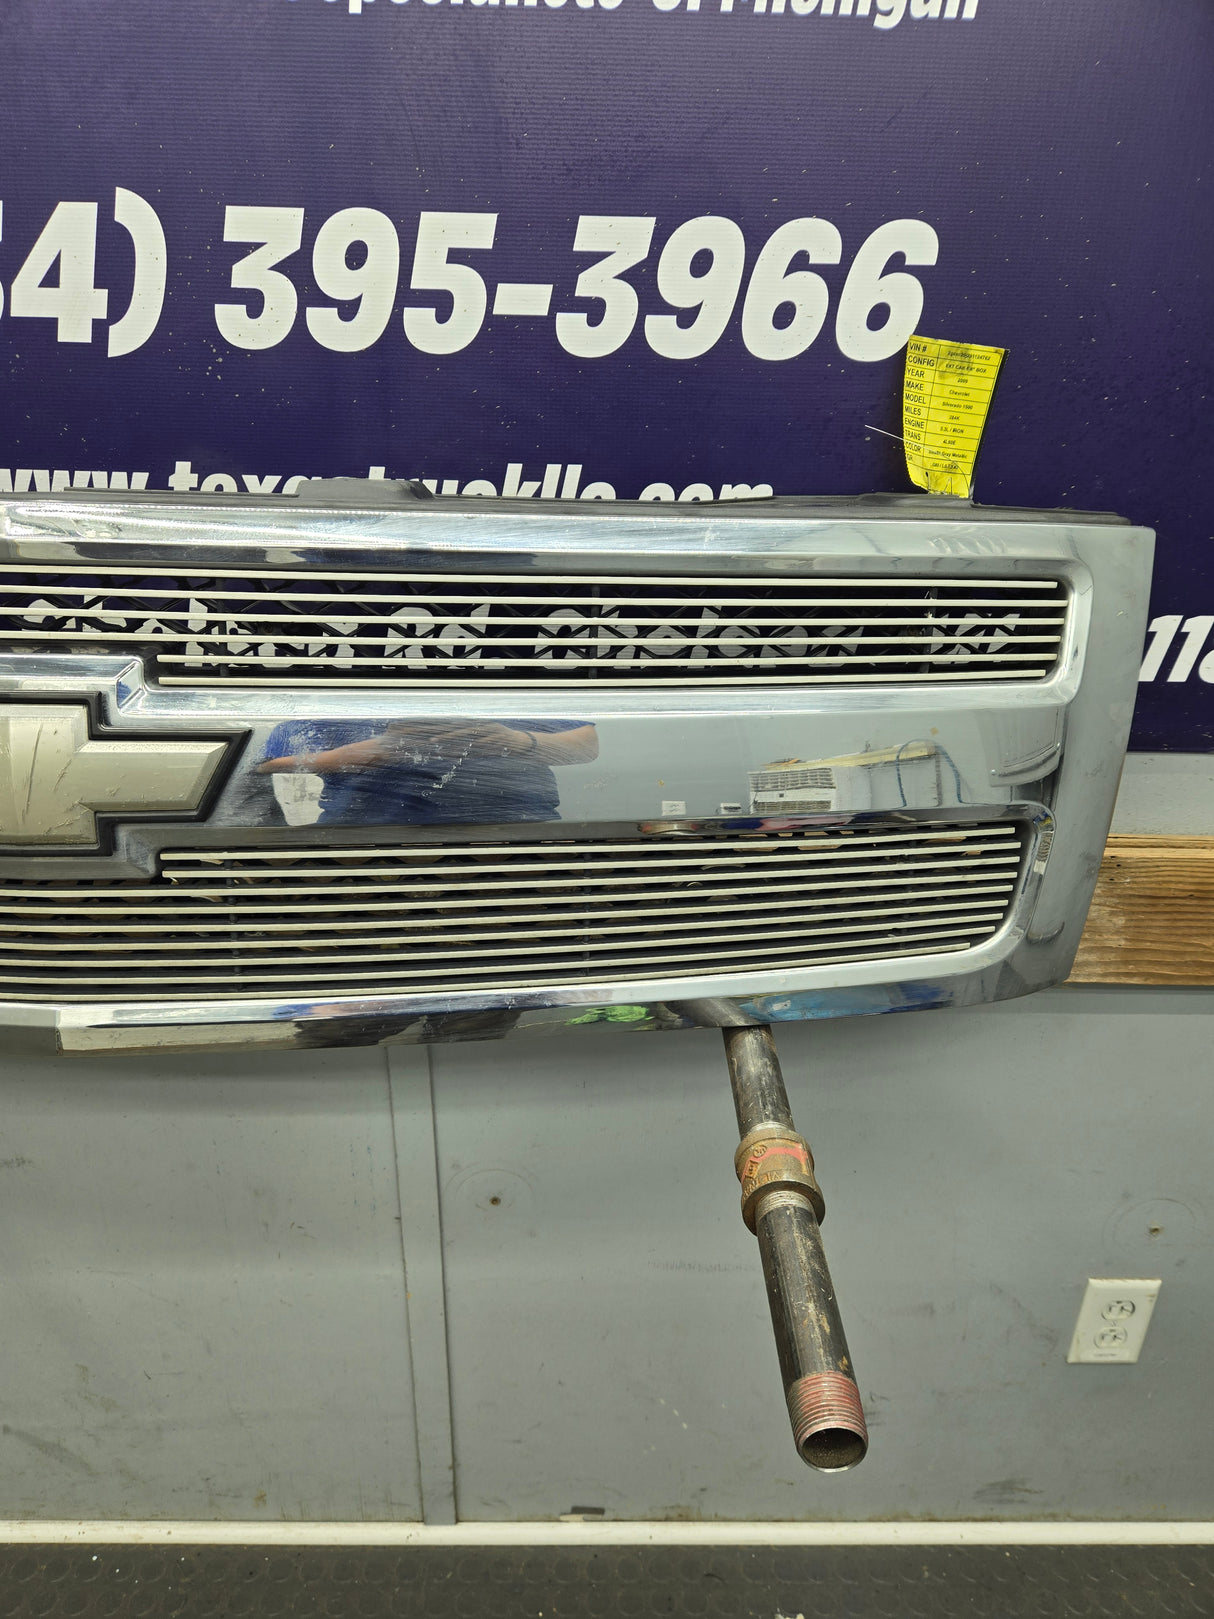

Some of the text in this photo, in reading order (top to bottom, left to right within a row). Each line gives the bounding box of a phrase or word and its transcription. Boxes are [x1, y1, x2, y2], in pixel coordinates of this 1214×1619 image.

[0, 187, 940, 362] 4) 395-3966
[908, 355, 935, 367] CONFIG
[906, 367, 925, 378] YEAR
[905, 380, 924, 391] MAKE
[904, 393, 926, 404] MODEL
[904, 406, 921, 416] MILES
[904, 417, 925, 429] ENGINE
[904, 430, 921, 441] TRANS
[906, 441, 921, 452] COLOR
